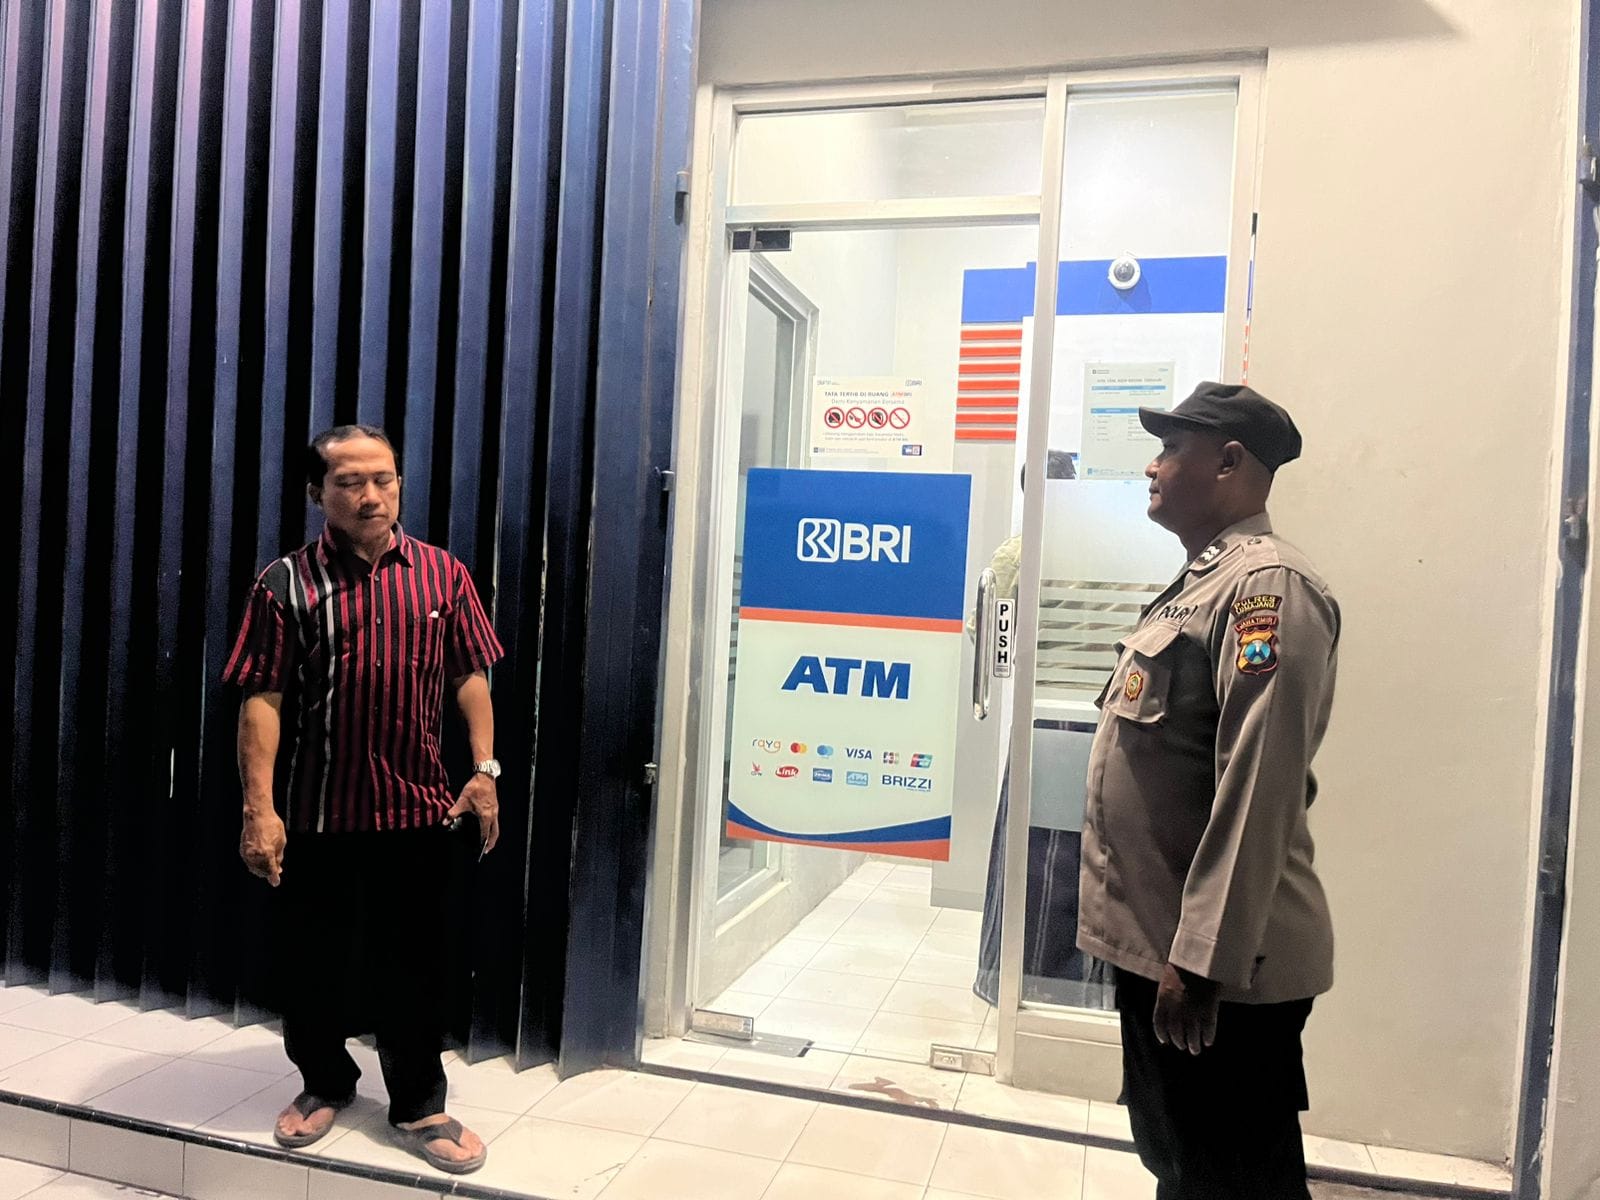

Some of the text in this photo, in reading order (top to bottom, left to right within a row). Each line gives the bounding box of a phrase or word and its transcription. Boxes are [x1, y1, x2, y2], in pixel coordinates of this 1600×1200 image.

[842, 522, 912, 564] BRI
[1233, 596, 1276, 609] POLRES
[997, 603, 1009, 664] PUSH
[781, 655, 911, 700] ATM
[846, 747, 872, 760] VISA
[776, 767, 798, 777] Link
[882, 775, 931, 789] BRIZZI
